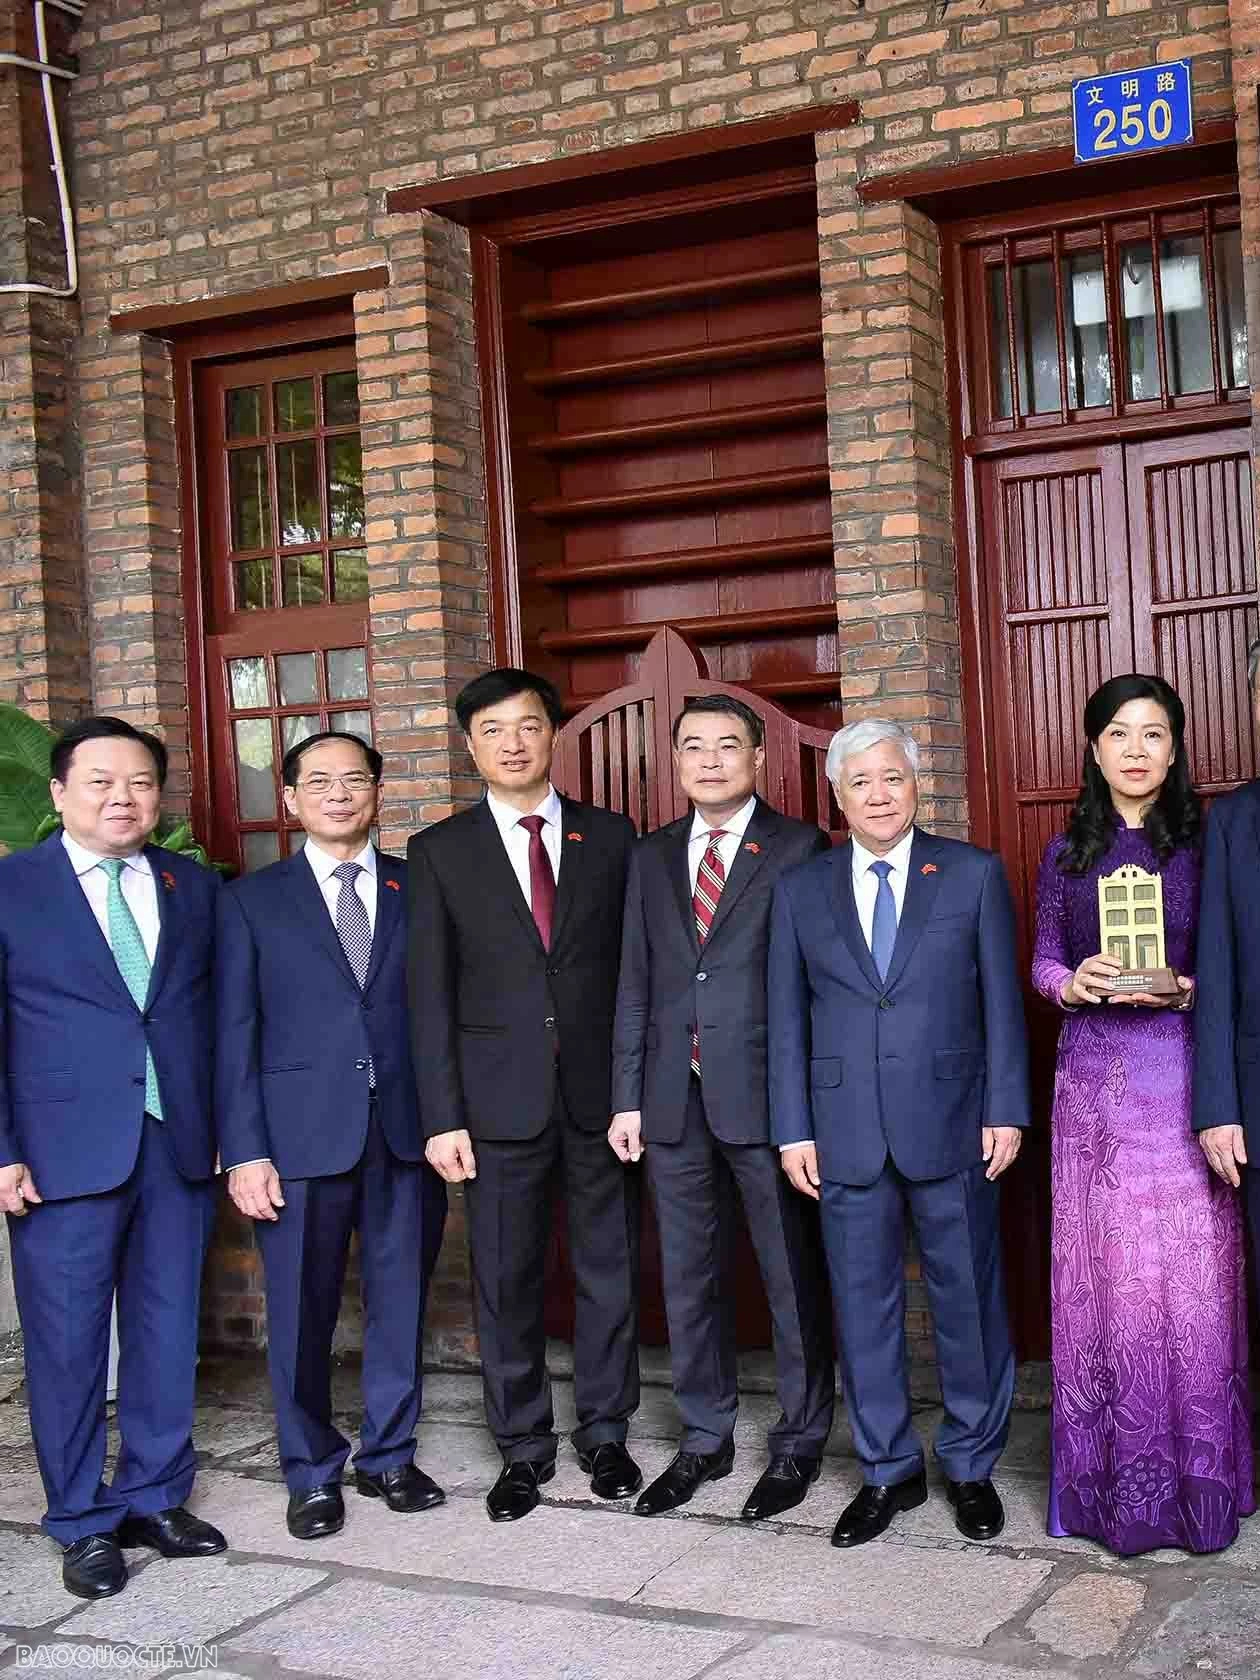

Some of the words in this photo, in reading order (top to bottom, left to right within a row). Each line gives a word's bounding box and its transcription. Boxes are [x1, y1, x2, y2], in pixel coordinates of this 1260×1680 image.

[1086, 72, 1176, 106] 文明路
[1094, 98, 1172, 151] 250
